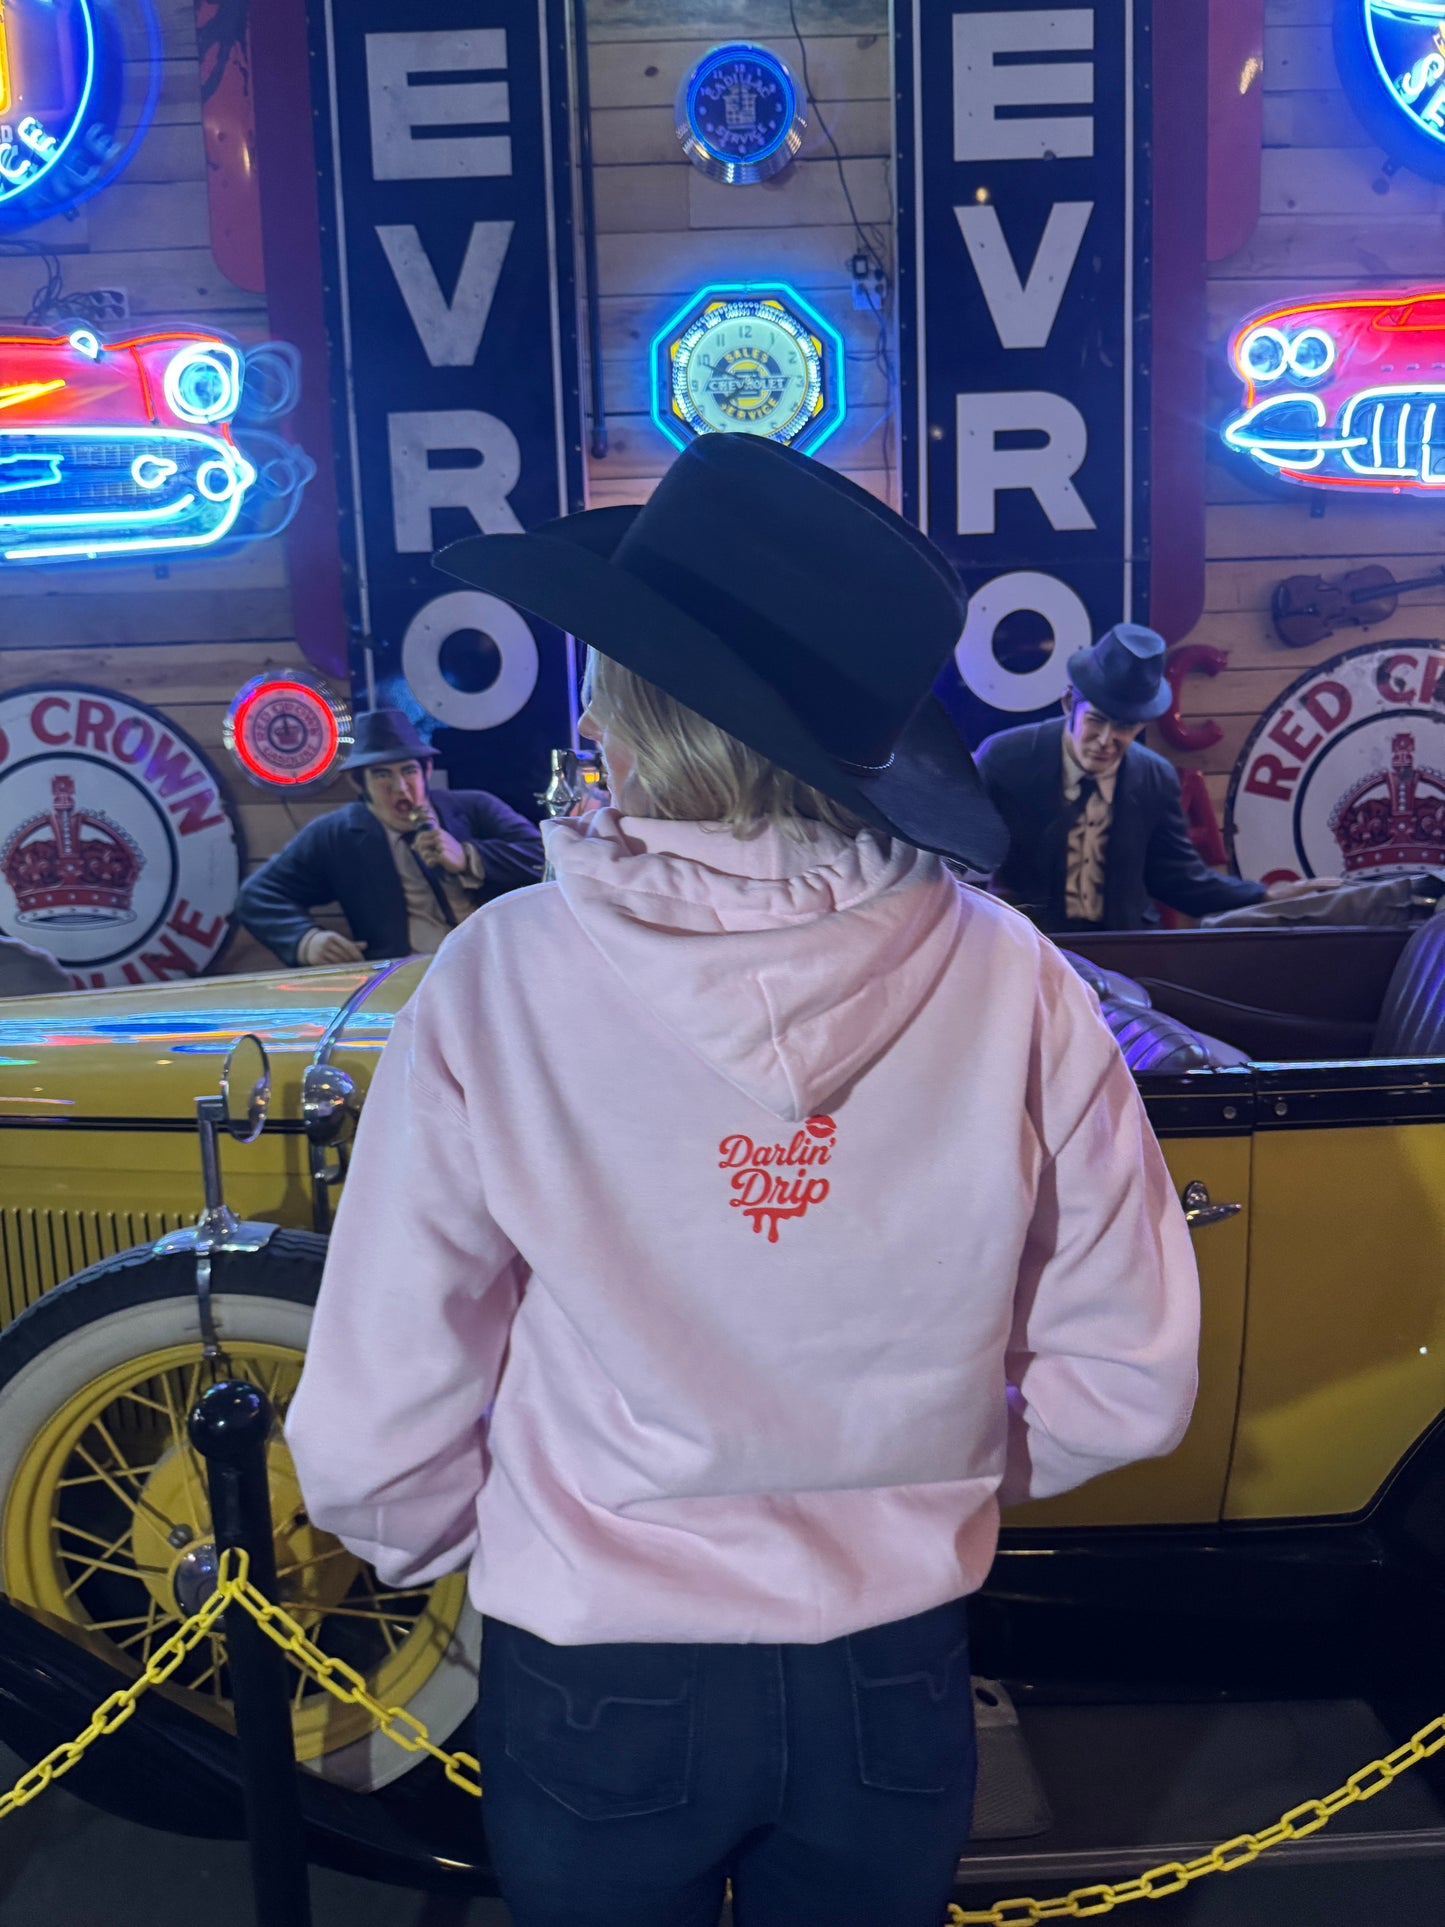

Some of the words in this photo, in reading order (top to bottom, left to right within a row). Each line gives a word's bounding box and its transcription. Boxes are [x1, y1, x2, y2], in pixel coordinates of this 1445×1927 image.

[710, 72, 772, 100] CADILLAC
[716, 333, 726, 347] 11
[738, 325, 753, 339] 12
[724, 347, 769, 363] SALES
[1244, 680, 1353, 802] RED
[30, 697, 225, 836] CROWN
[718, 1130, 836, 1168] Darlin'
[729, 1168, 830, 1218] Drip
